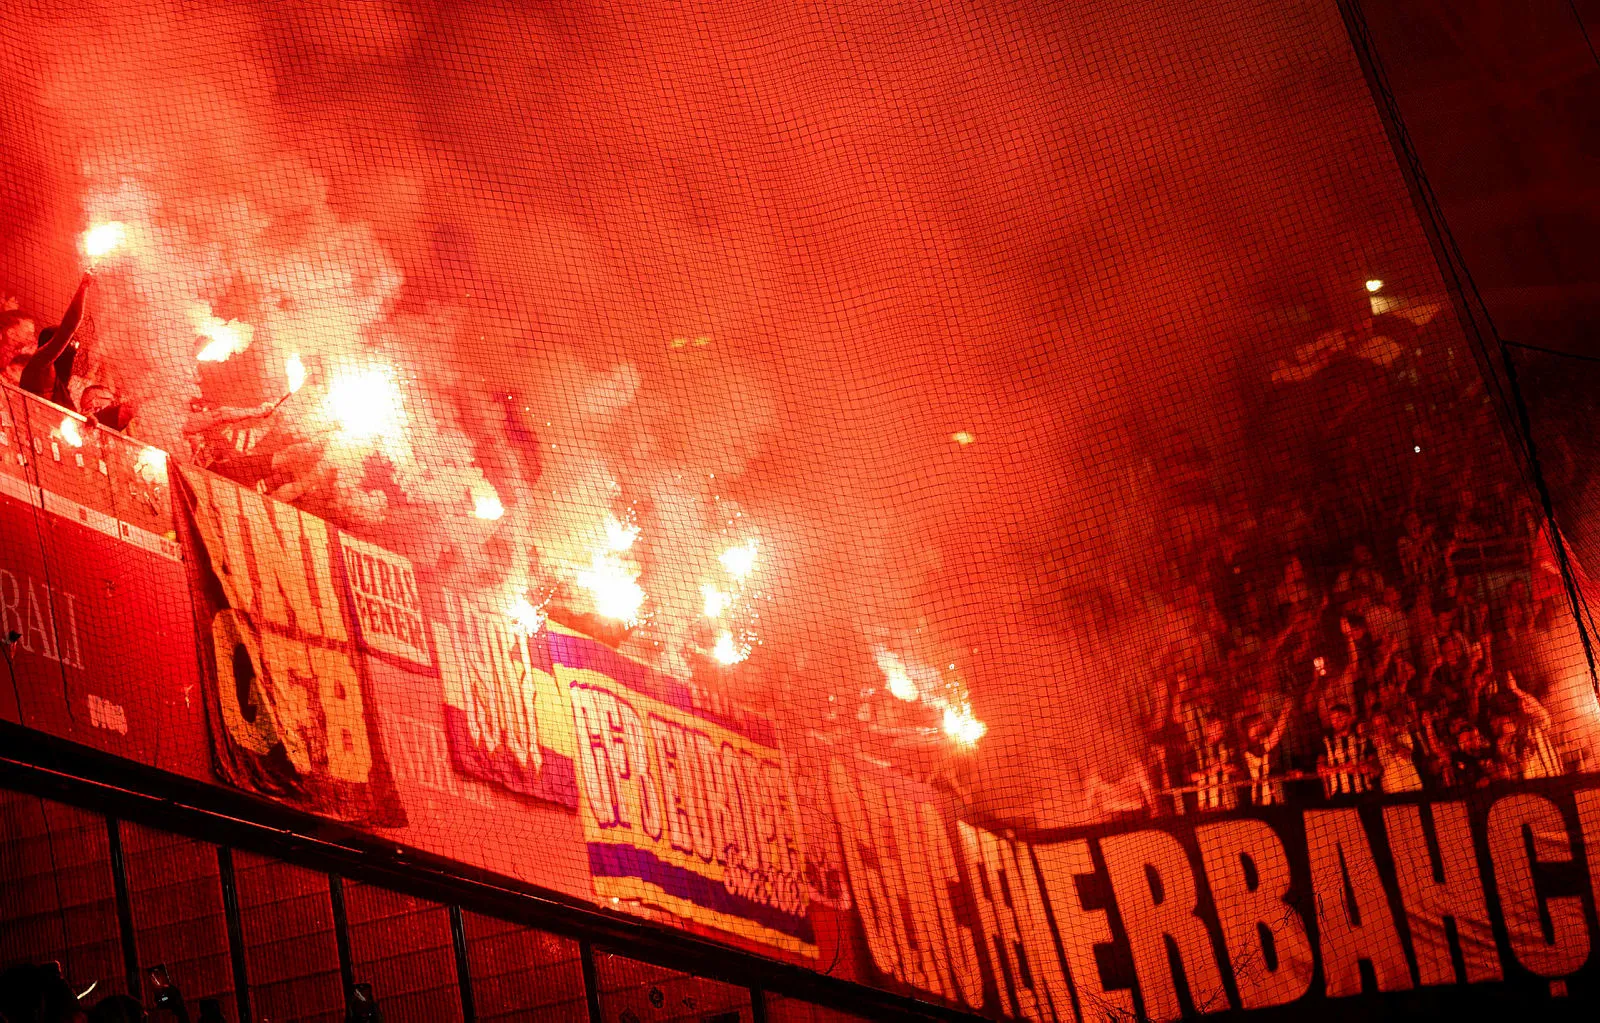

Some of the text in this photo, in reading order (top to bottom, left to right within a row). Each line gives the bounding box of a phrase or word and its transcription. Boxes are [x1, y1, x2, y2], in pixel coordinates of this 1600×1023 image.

[569, 680, 663, 841] GFB
[648, 712, 798, 876] EUROPE
[957, 787, 1600, 1023] FENERBAHÇ
